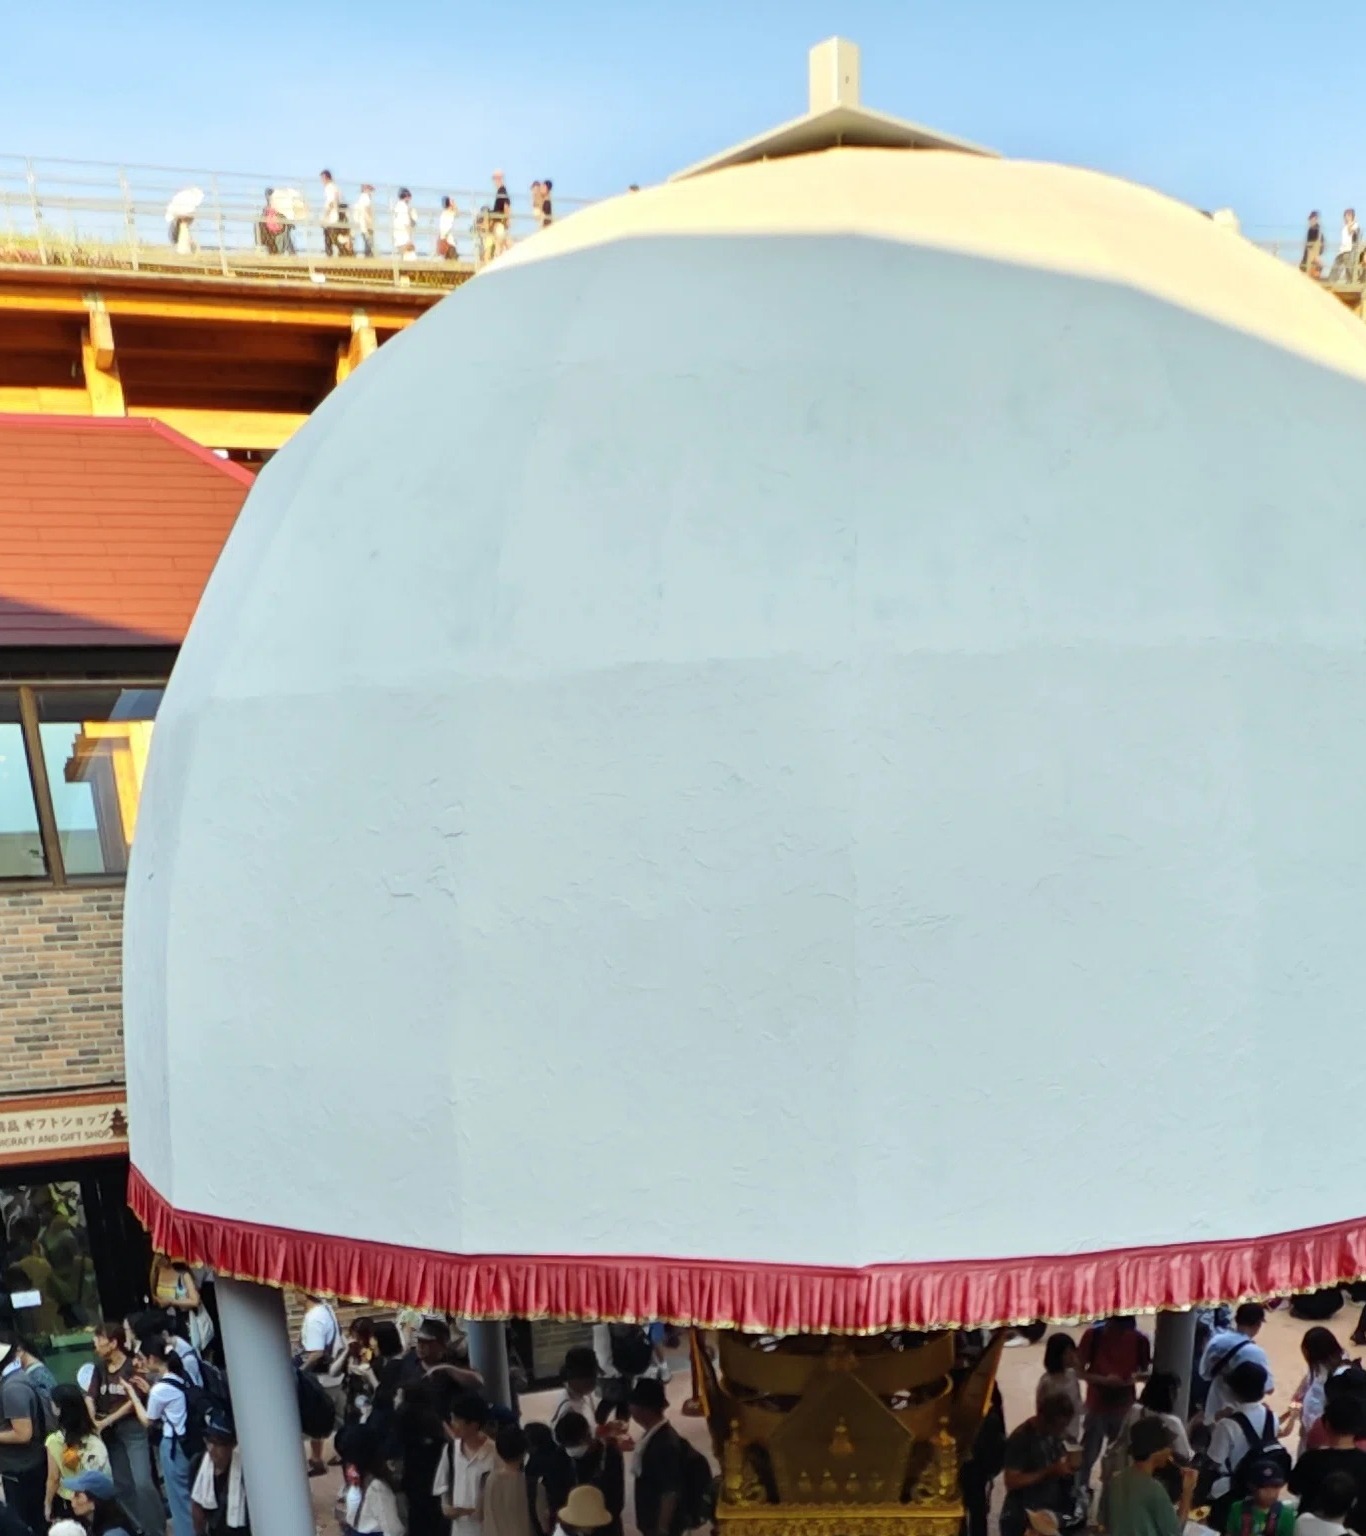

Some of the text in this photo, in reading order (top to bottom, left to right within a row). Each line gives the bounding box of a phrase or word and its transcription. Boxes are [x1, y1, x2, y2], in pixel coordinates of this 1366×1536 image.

[24, 1111, 110, 1130] ギフトショップ
[38, 1132, 59, 1144] AND
[60, 1130, 81, 1142] GIFT
[83, 1128, 110, 1141] SHOP
